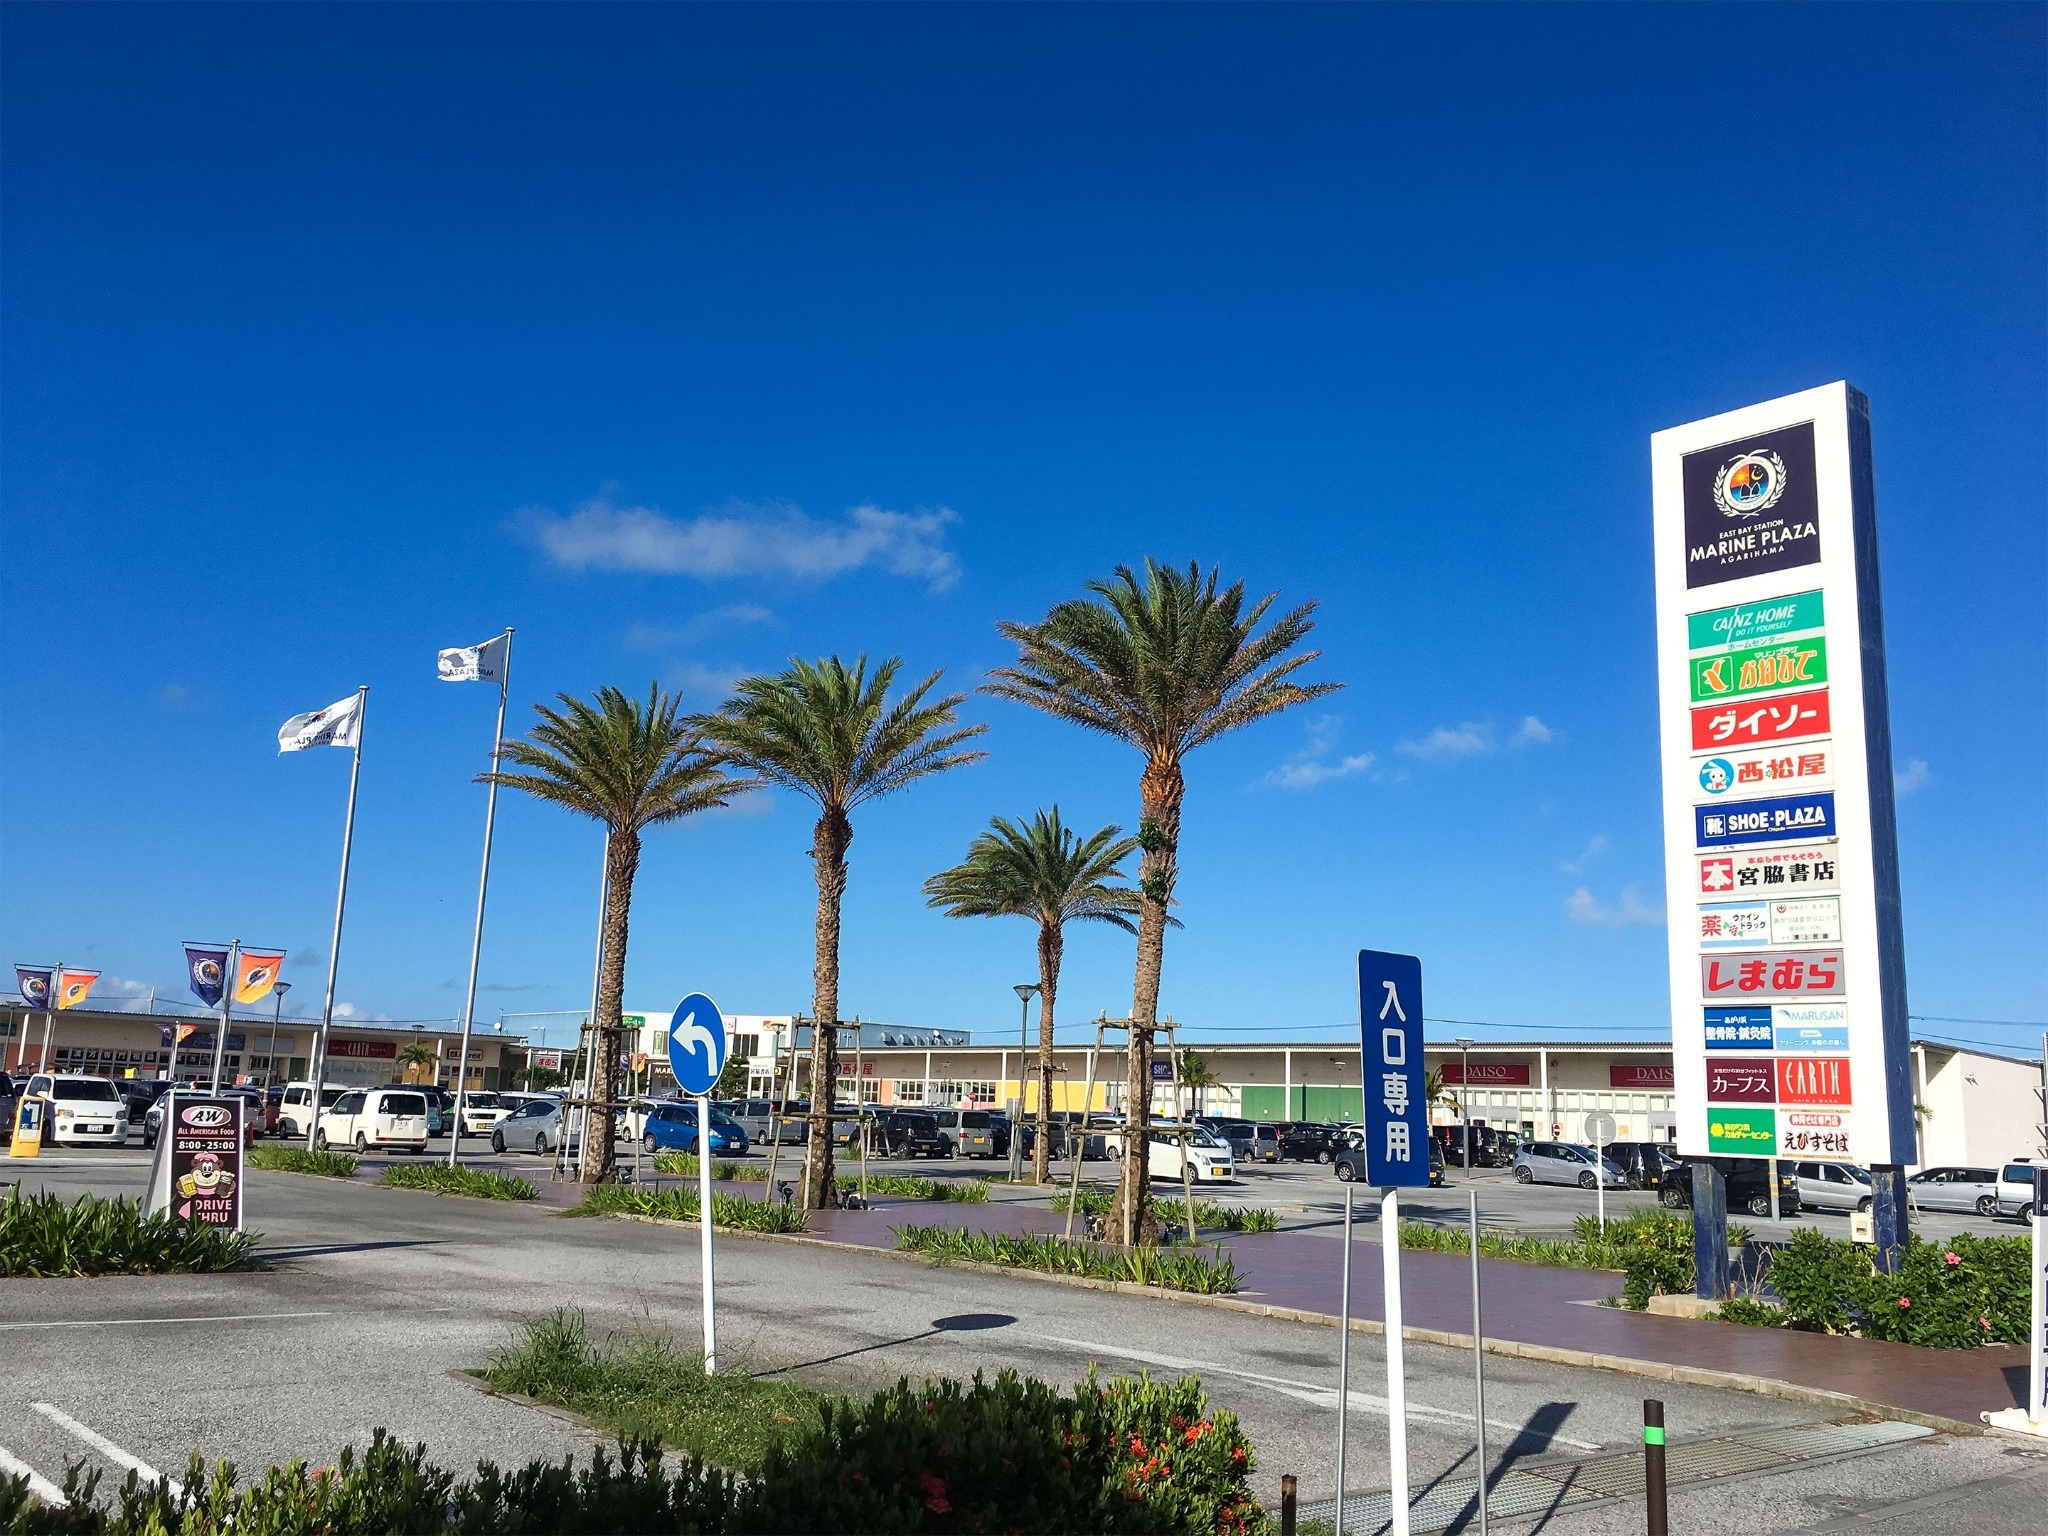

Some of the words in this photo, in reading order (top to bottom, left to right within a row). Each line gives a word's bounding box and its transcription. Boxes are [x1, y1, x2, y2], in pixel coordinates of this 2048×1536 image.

[1720, 528, 1736, 539] EAST
[1738, 525, 1752, 535] BAY
[1754, 519, 1784, 531] STATION
[1690, 534, 1756, 562] MARINE
[1761, 521, 1817, 546] PLAZA
[1720, 545, 1785, 565] AGARIHAMA
[1713, 609, 1753, 634] CAINZ
[1755, 604, 1797, 624] HOME
[1735, 628, 1746, 636] DO
[1747, 627, 1755, 636] IT
[1756, 620, 1793, 633] YOURSELF
[1727, 636, 1785, 651] ホームセンター
[1708, 704, 1817, 740] ダイソー
[1737, 753, 1826, 783] 西松屋
[1748, 851, 1823, 864] 本なら何でもそろう
[1702, 861, 1733, 891] 本
[1737, 861, 1835, 886] 宮脇書店
[1702, 915, 1722, 937] 薬
[1708, 957, 1838, 991] しまむら
[1791, 1010, 1844, 1021] MARUSAN
[538, 1057, 559, 1067] まむら
[1379, 980, 1411, 1163] 入口専用
[1636, 1067, 1674, 1080] DAIS
[1785, 1061, 1840, 1094] EARTH
[1712, 1076, 1771, 1093] カーブス
[1784, 1131, 1849, 1152] えびすそば
[195, 1200, 232, 1211] DRIVE
